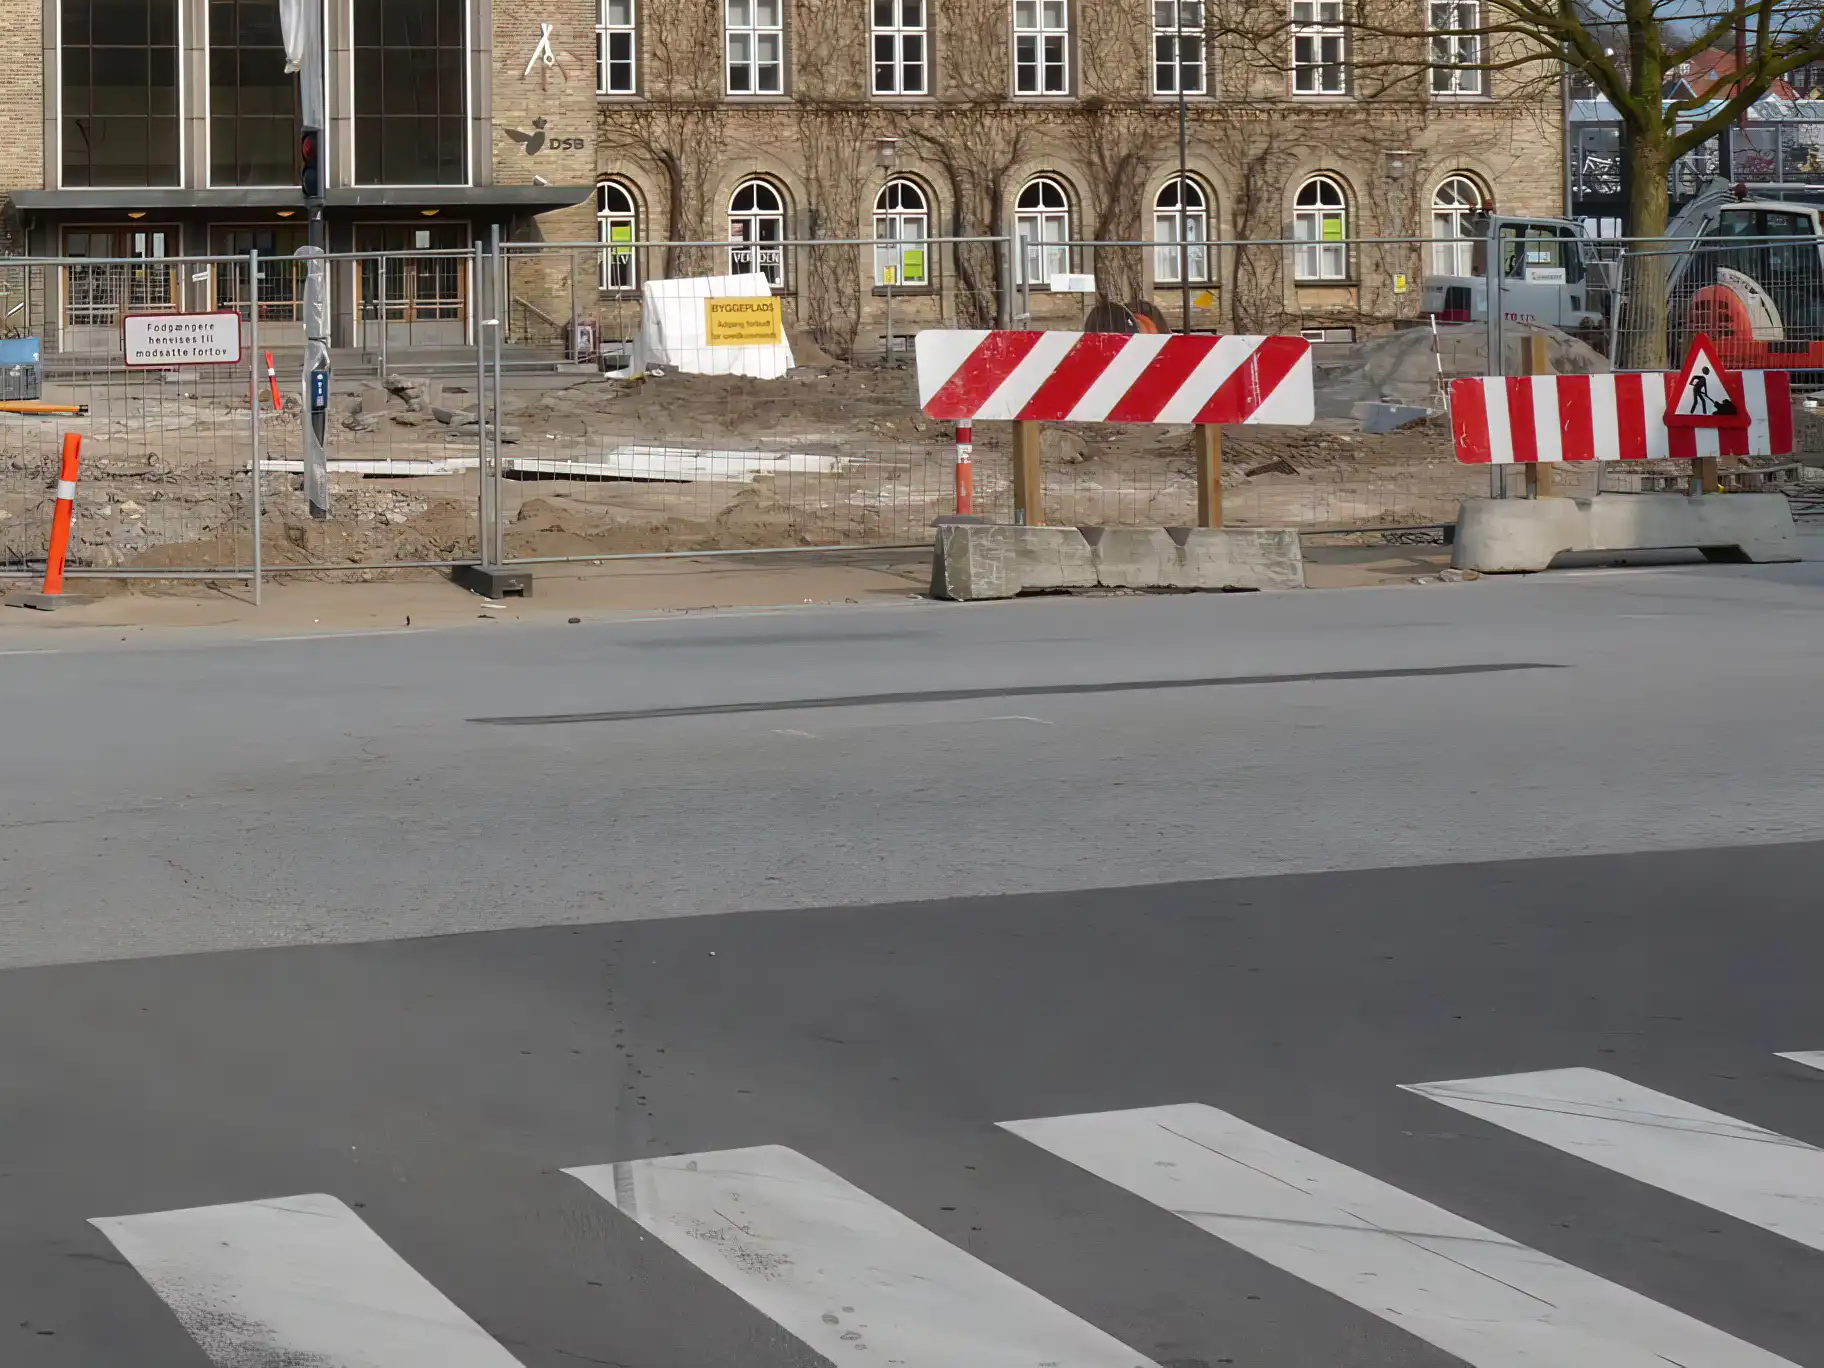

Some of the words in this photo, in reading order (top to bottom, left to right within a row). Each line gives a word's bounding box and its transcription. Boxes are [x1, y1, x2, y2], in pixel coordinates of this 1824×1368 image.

[549, 138, 584, 150] DSB
[712, 303, 774, 313] BYGGEPLADS
[147, 323, 215, 333] Fodgængere
[148, 336, 197, 344] henvises
[201, 335, 214, 343] til
[136, 348, 188, 357] modsatte
[193, 347, 227, 356] fortov
